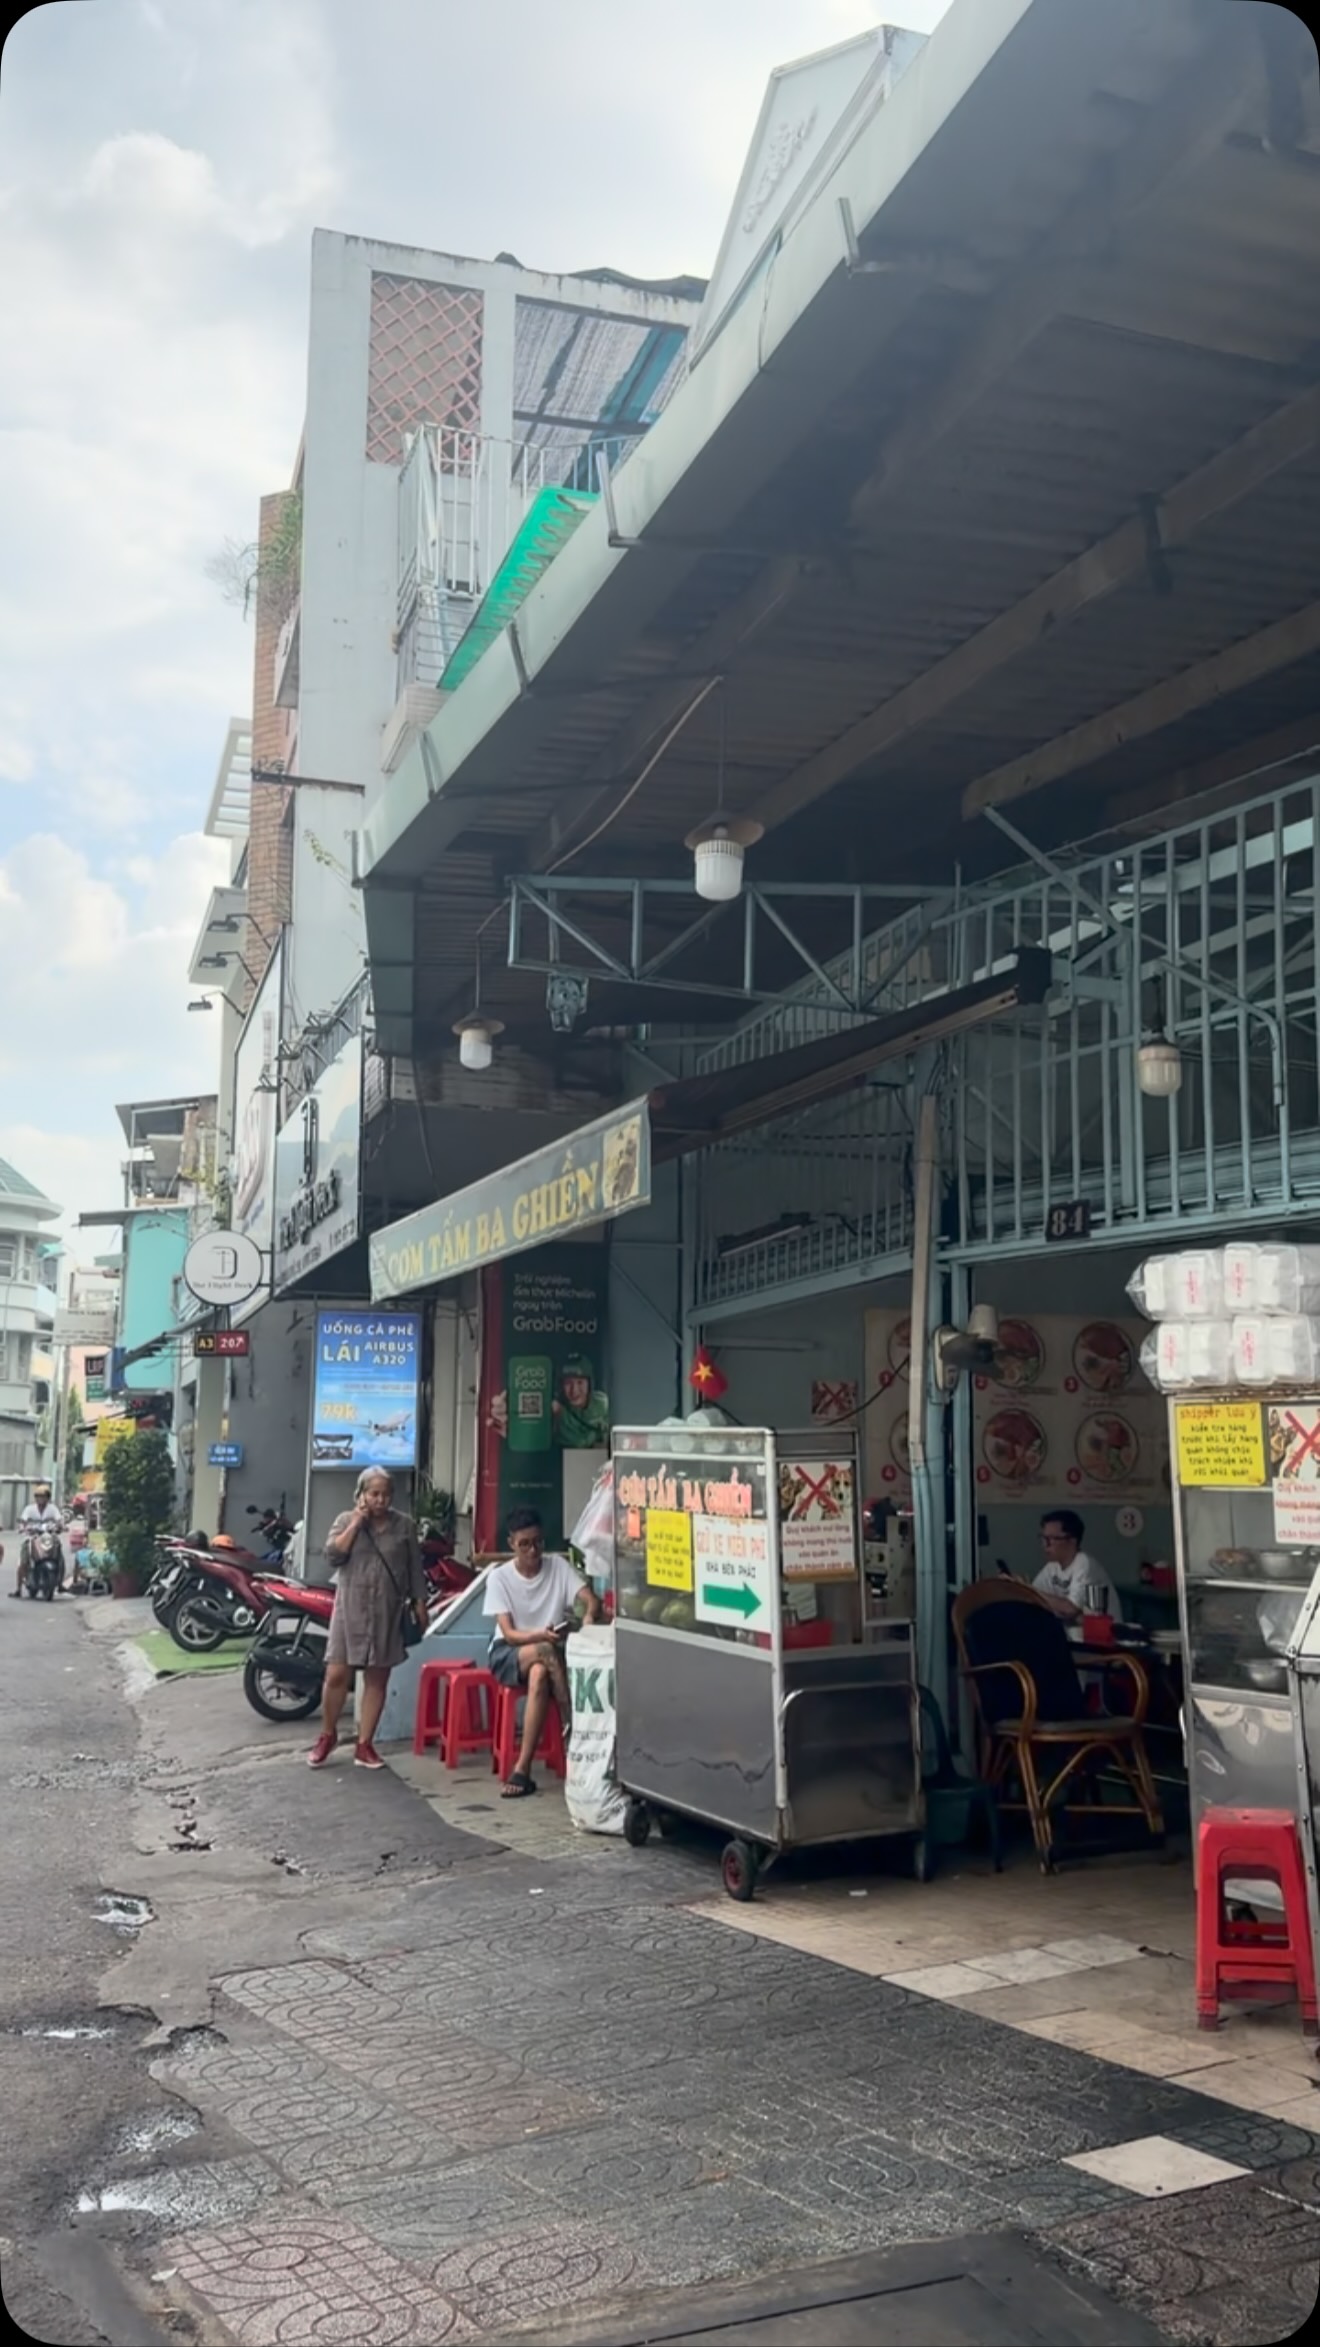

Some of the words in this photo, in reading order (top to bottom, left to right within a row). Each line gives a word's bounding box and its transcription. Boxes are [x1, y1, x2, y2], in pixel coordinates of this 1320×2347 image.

[388, 1239, 424, 1284] CƠM
[428, 1210, 470, 1275] TẤM
[476, 1206, 506, 1255] BA
[512, 1149, 599, 1241] GHIỀN
[1052, 1206, 1083, 1236] 84
[323, 1319, 363, 1335] UỐNG
[366, 1322, 385, 1336] CÀ
[388, 1321, 415, 1336] PHÊ
[513, 1316, 597, 1333] GrabFood
[199, 1338, 214, 1349] A3
[323, 1339, 361, 1362] LÁI
[364, 1341, 414, 1352] AIRBUS
[372, 1354, 406, 1365] A320
[515, 1365, 546, 1379] Grab
[515, 1377, 547, 1389] Food
[1180, 1406, 1219, 1420] shipper
[1124, 1512, 1136, 1531] 3
